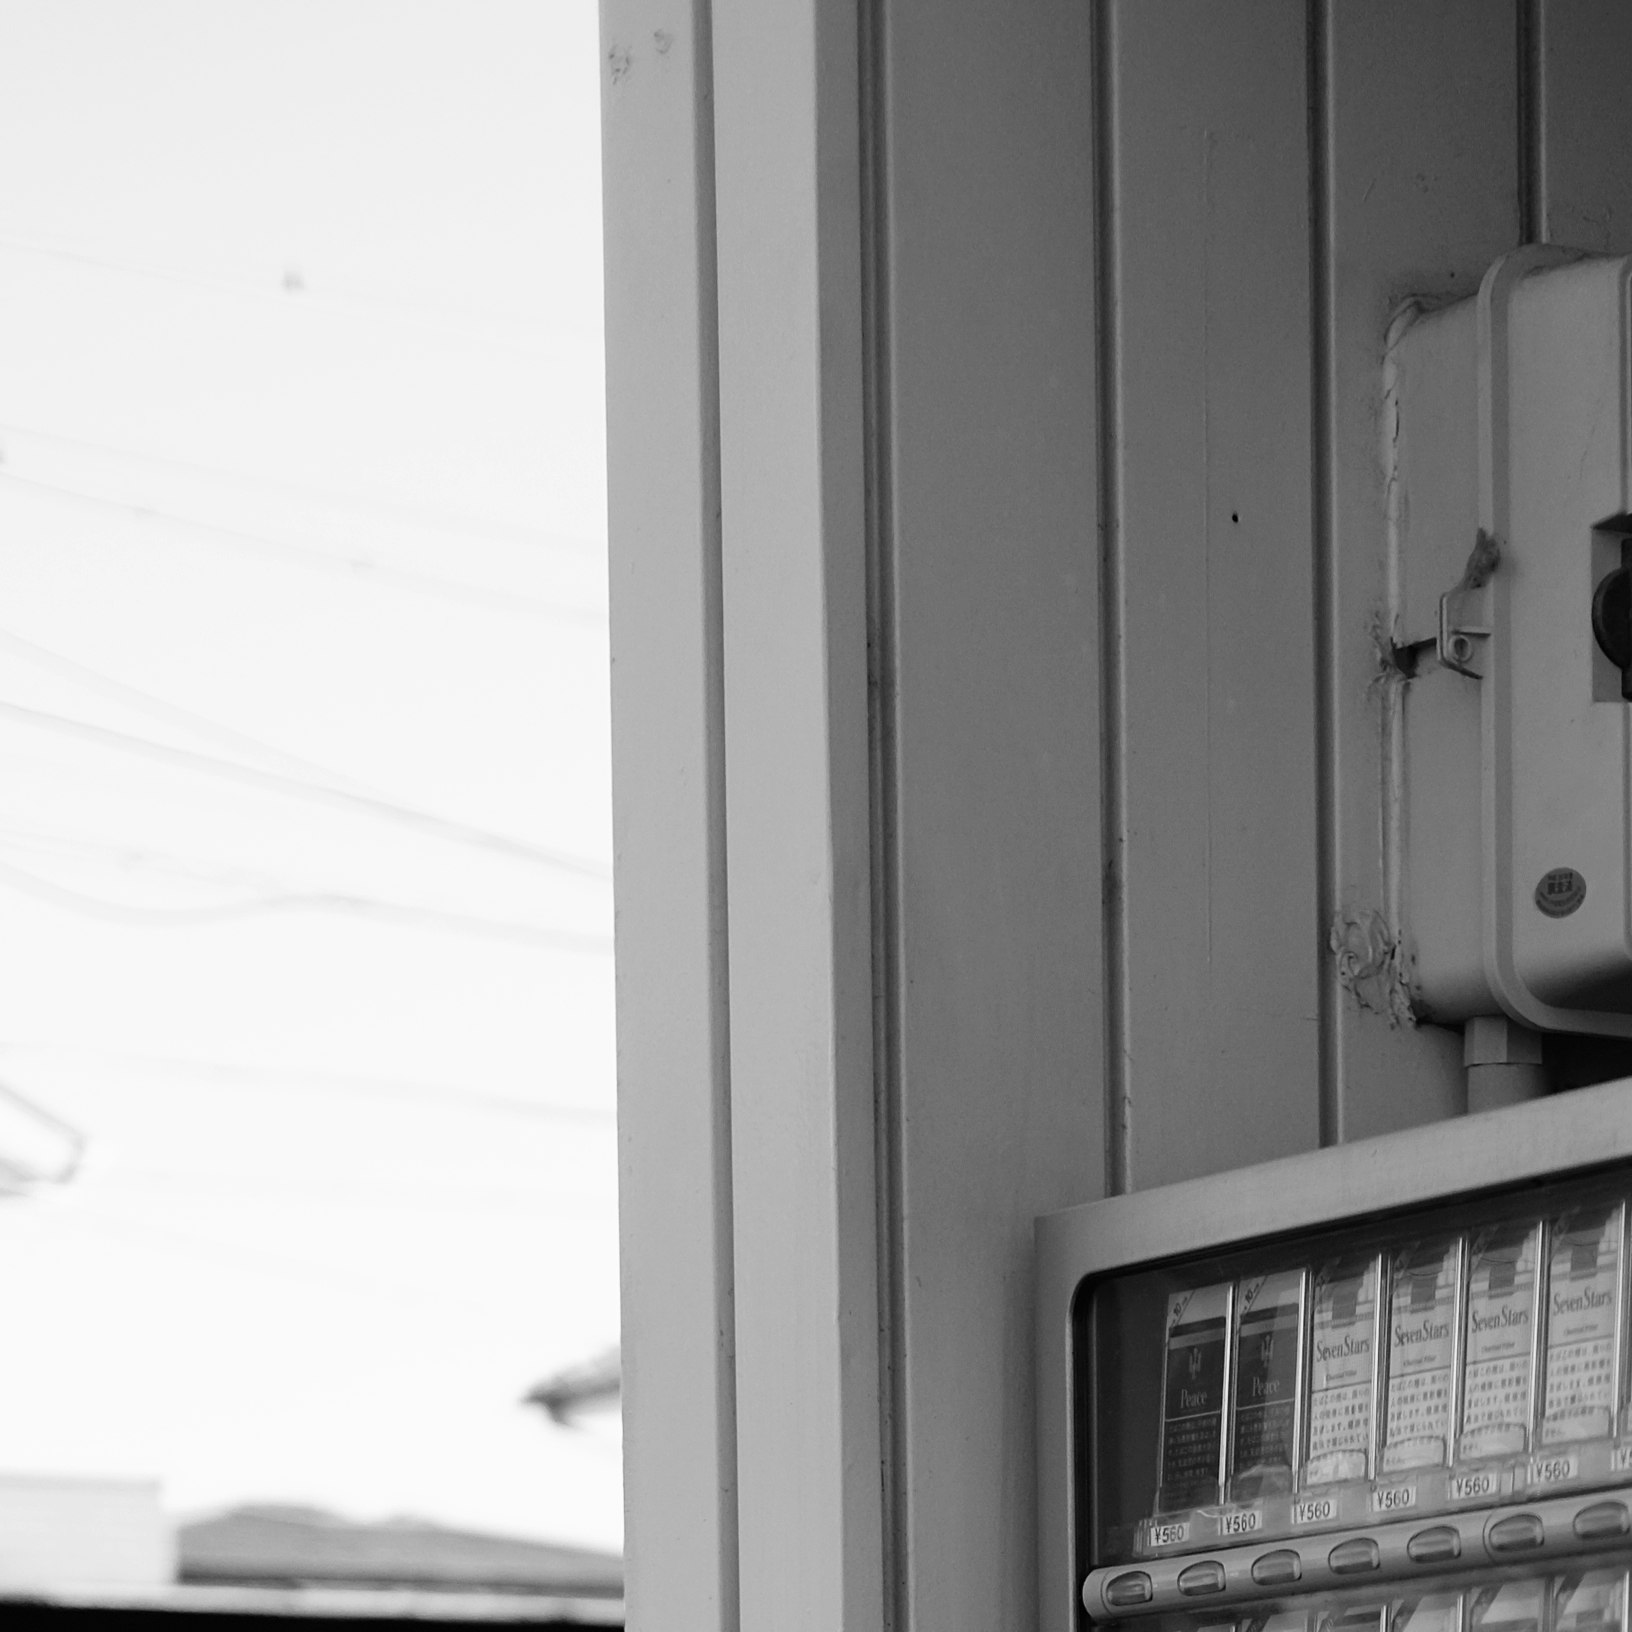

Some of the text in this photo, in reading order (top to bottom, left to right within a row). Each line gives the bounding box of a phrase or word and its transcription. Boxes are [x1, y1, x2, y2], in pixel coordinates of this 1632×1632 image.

[1252, 1376, 1280, 1397] Peace
[1180, 1388, 1208, 1409] Peace
[1535, 1460, 1571, 1480] ¥560
[1456, 1475, 1490, 1496] ¥560
[1377, 1488, 1410, 1508] ¥560
[1299, 1500, 1331, 1522] ¥560
[1154, 1523, 1184, 1543] ¥560
[1225, 1512, 1257, 1534] ¥560
